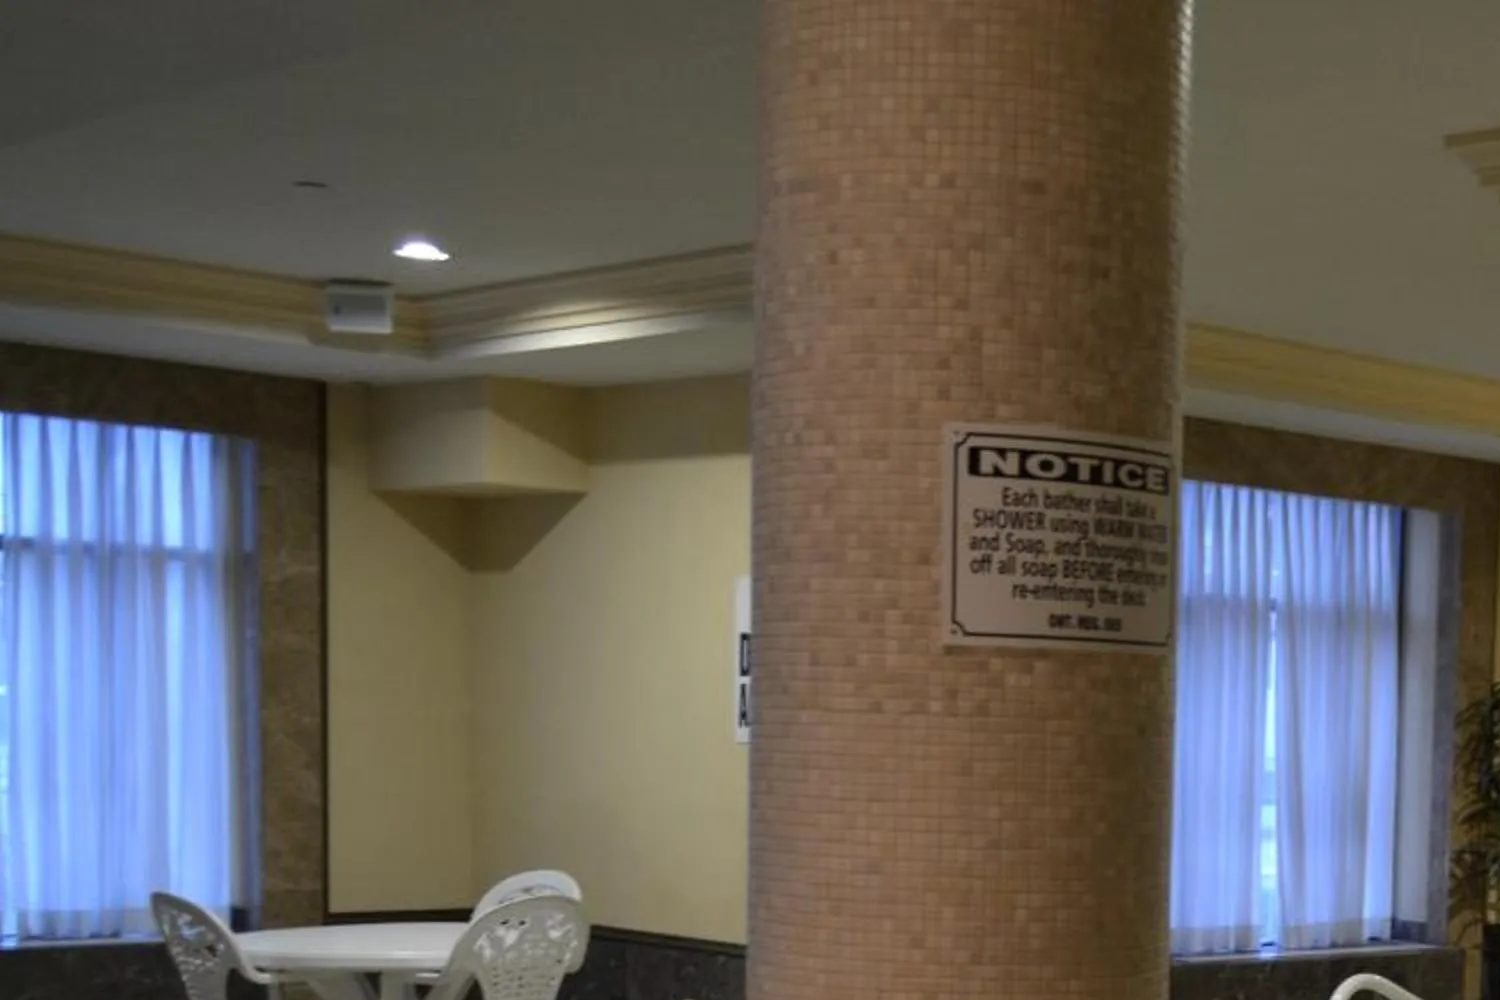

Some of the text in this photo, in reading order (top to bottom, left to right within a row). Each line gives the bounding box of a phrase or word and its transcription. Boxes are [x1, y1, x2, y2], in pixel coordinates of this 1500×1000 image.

[979, 448, 1167, 492] NOTICE
[1001, 486, 1039, 508] Each
[1043, 488, 1091, 513] bather
[972, 508, 1047, 531] SHOWER
[1050, 513, 1090, 541] using
[969, 533, 999, 551] and
[1054, 539, 1082, 556] and
[969, 553, 993, 575] off
[997, 554, 1016, 575] all
[1021, 560, 1058, 581] soap
[1062, 559, 1114, 582] BEFORE
[1012, 583, 1095, 608] re-entering
